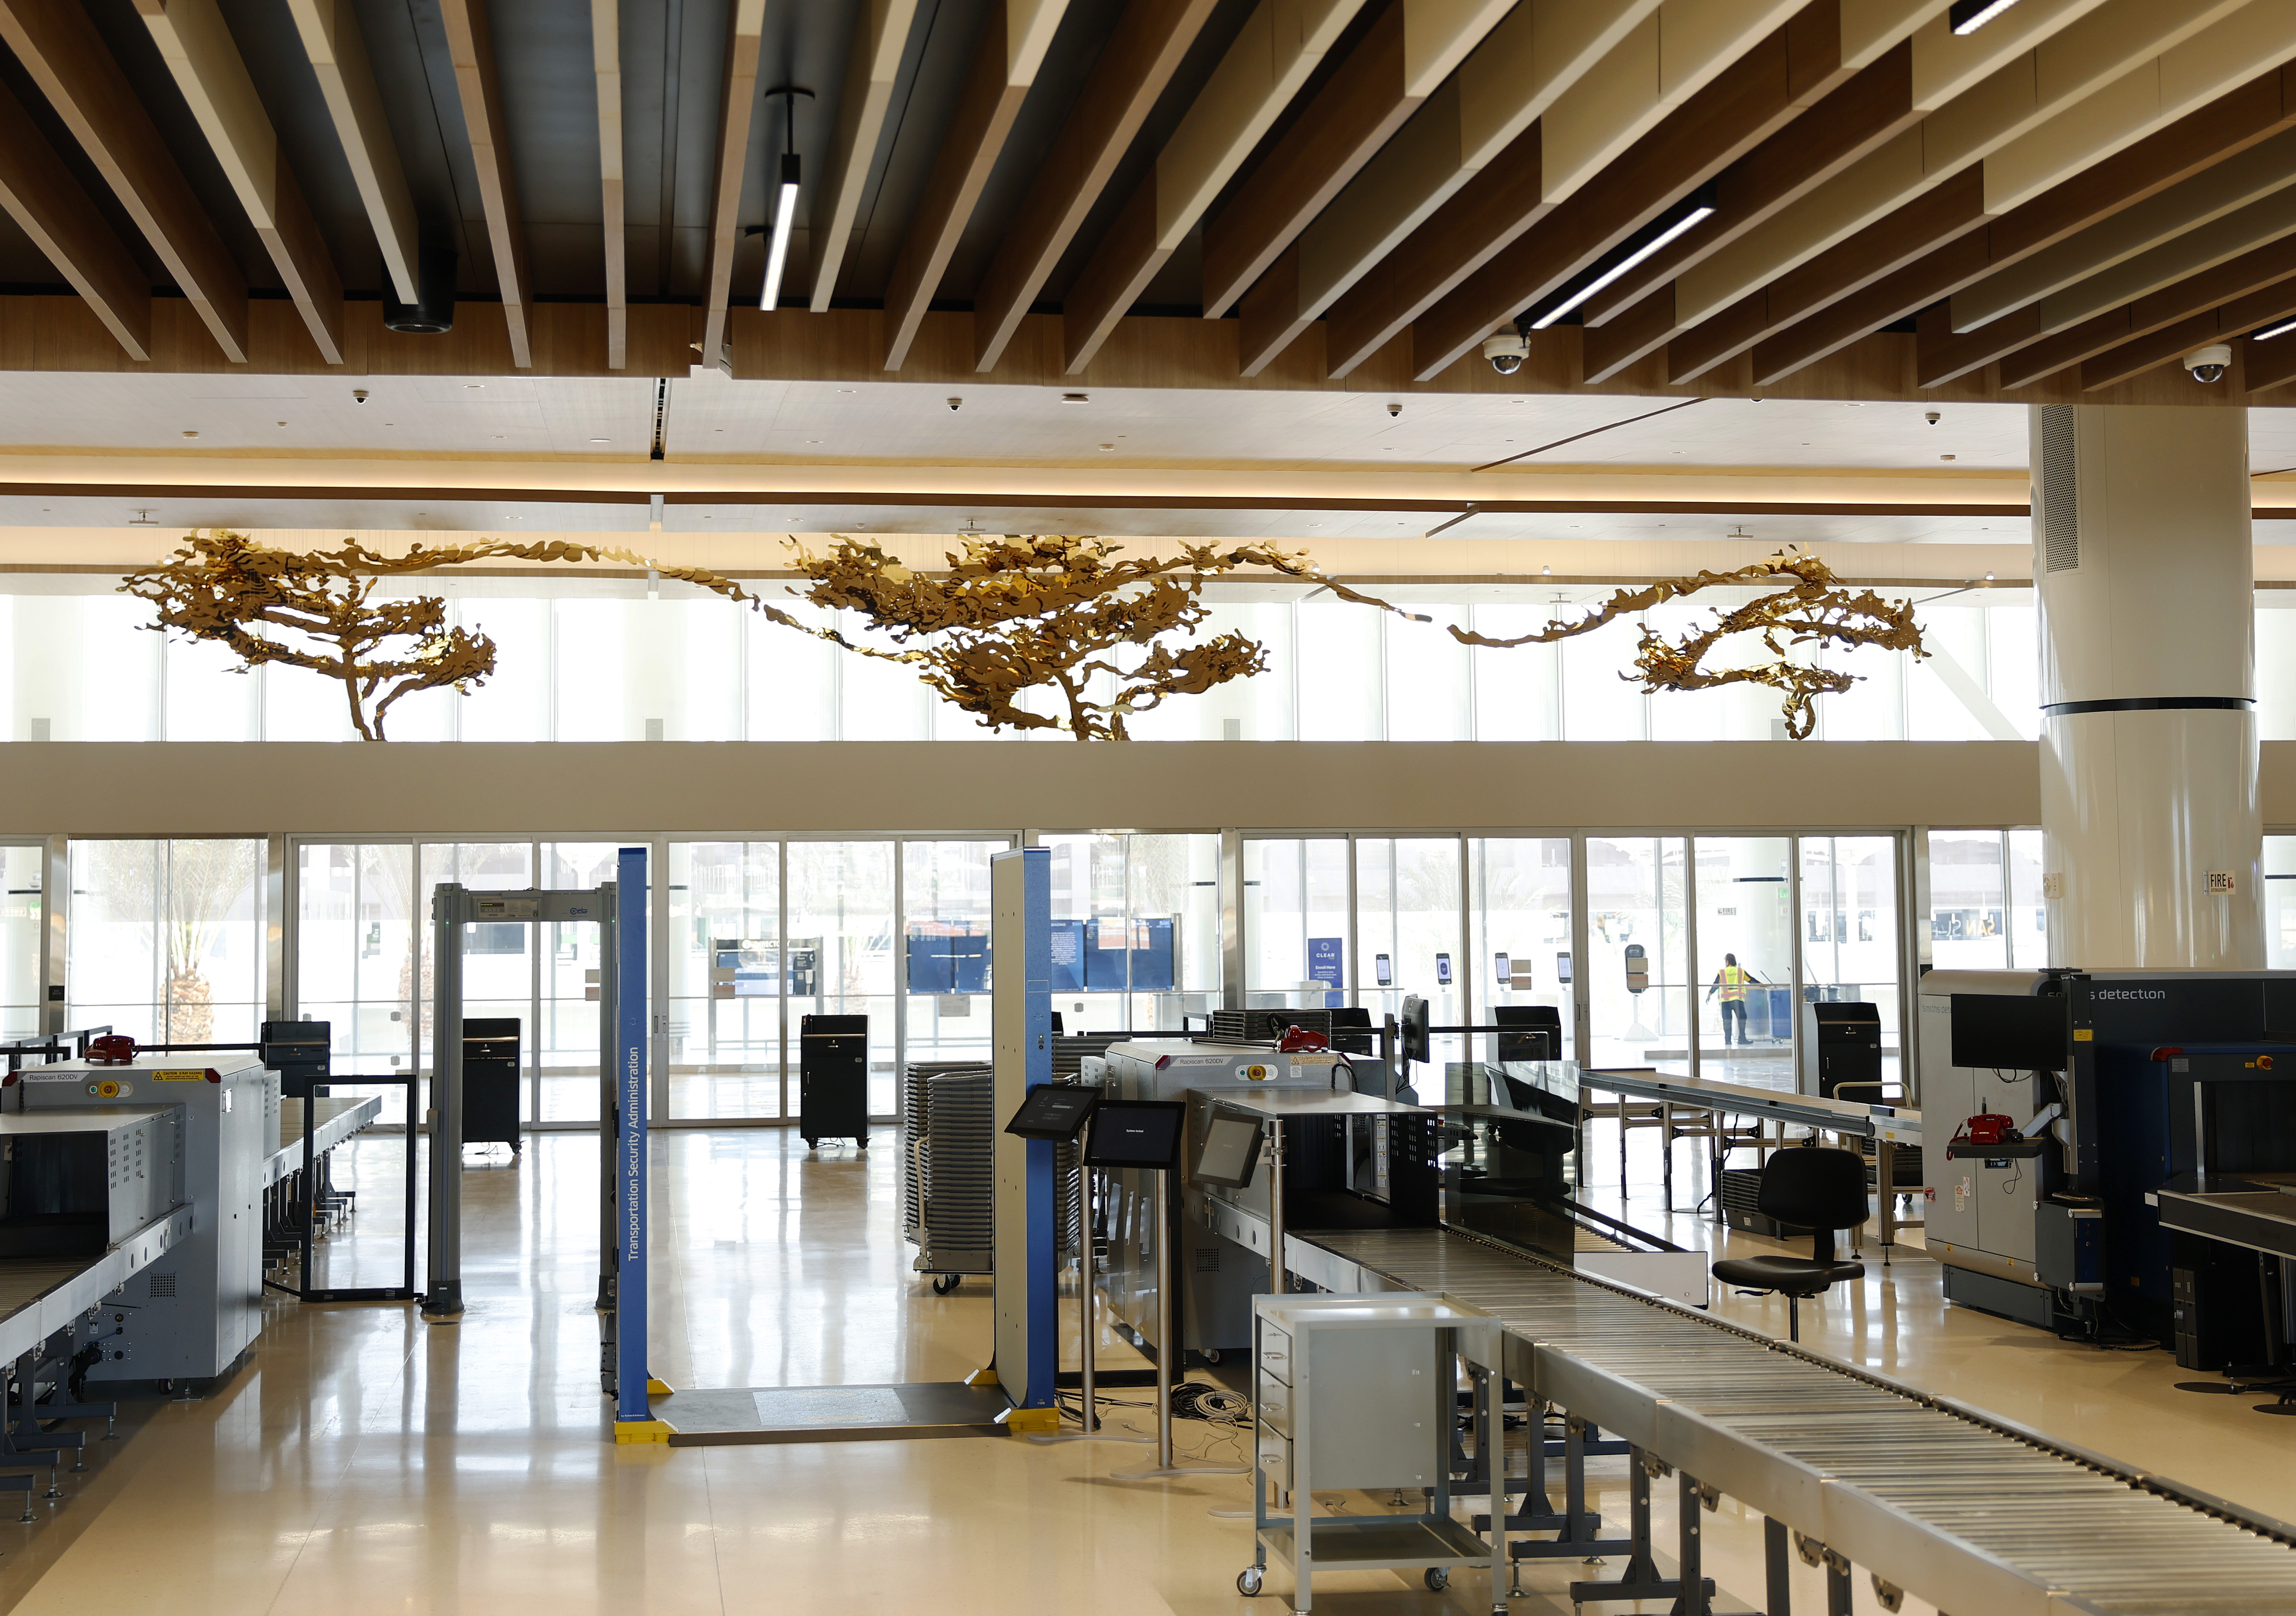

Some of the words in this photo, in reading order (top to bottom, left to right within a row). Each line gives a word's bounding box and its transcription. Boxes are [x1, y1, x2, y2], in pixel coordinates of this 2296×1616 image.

[2211, 874, 2226, 887] FIRE
[2098, 989, 2165, 1000] detection
[628, 1047, 639, 1129] Administration
[628, 1131, 640, 1176] Security
[628, 1179, 640, 1262] Transportation
